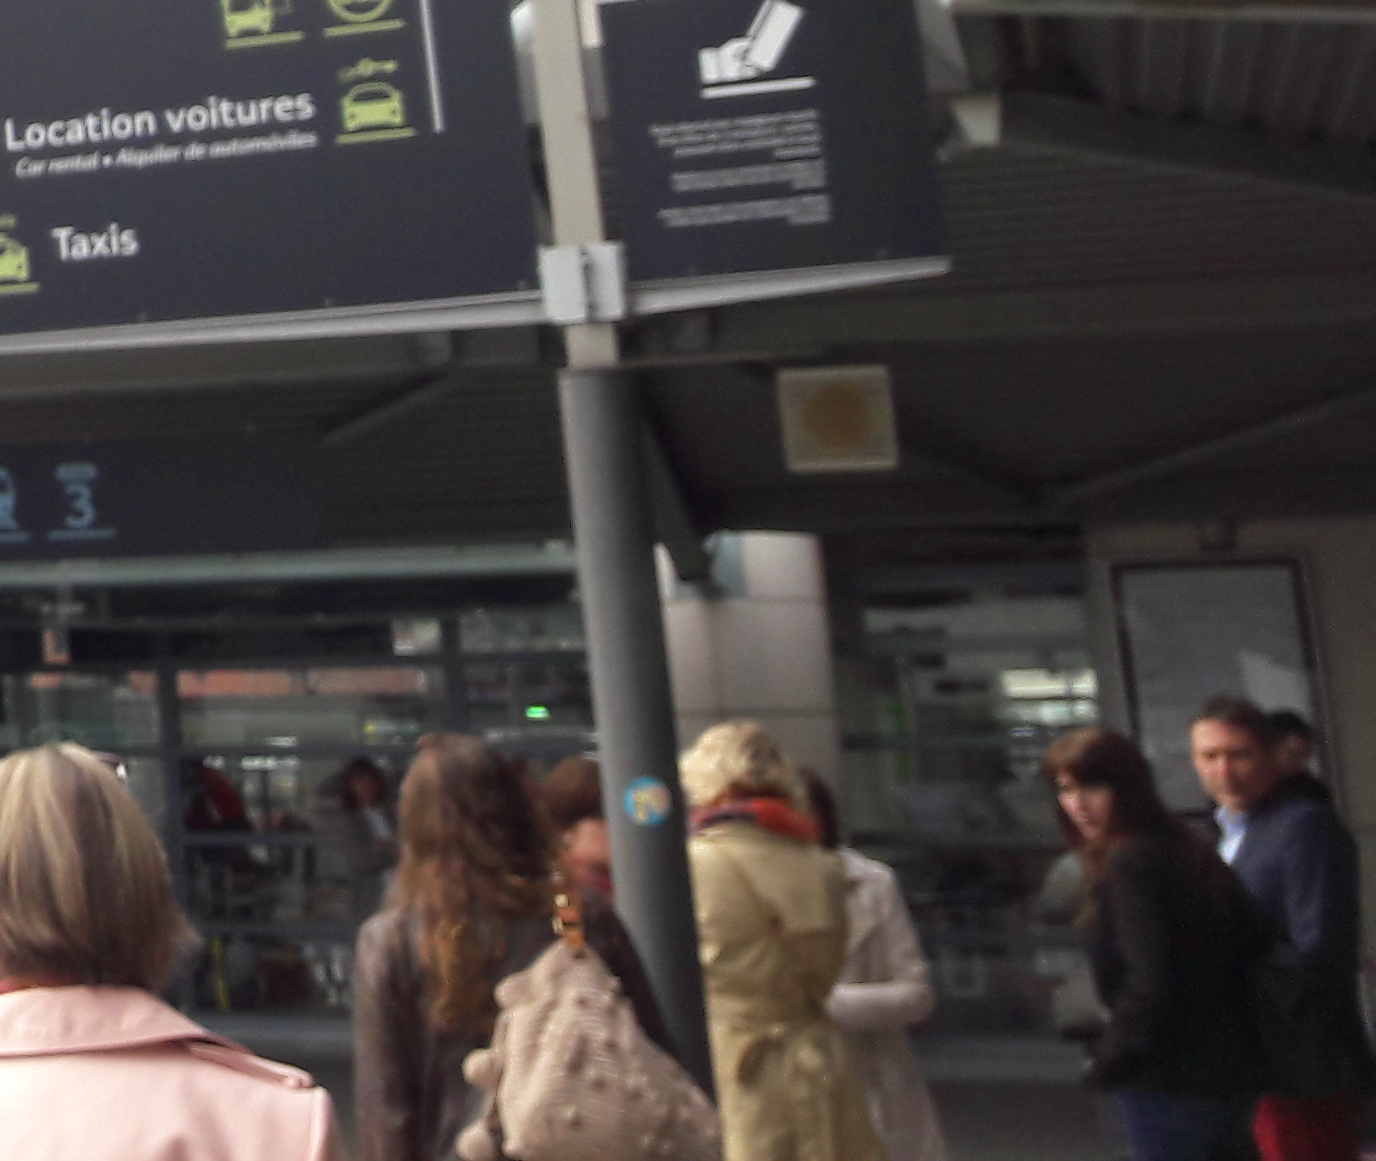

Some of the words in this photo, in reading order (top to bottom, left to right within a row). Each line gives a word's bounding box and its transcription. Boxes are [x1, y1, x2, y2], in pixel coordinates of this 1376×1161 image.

[5, 106, 159, 152] Location
[164, 92, 317, 134] voitures
[50, 220, 141, 262] Taxis
[65, 484, 96, 529] 3
